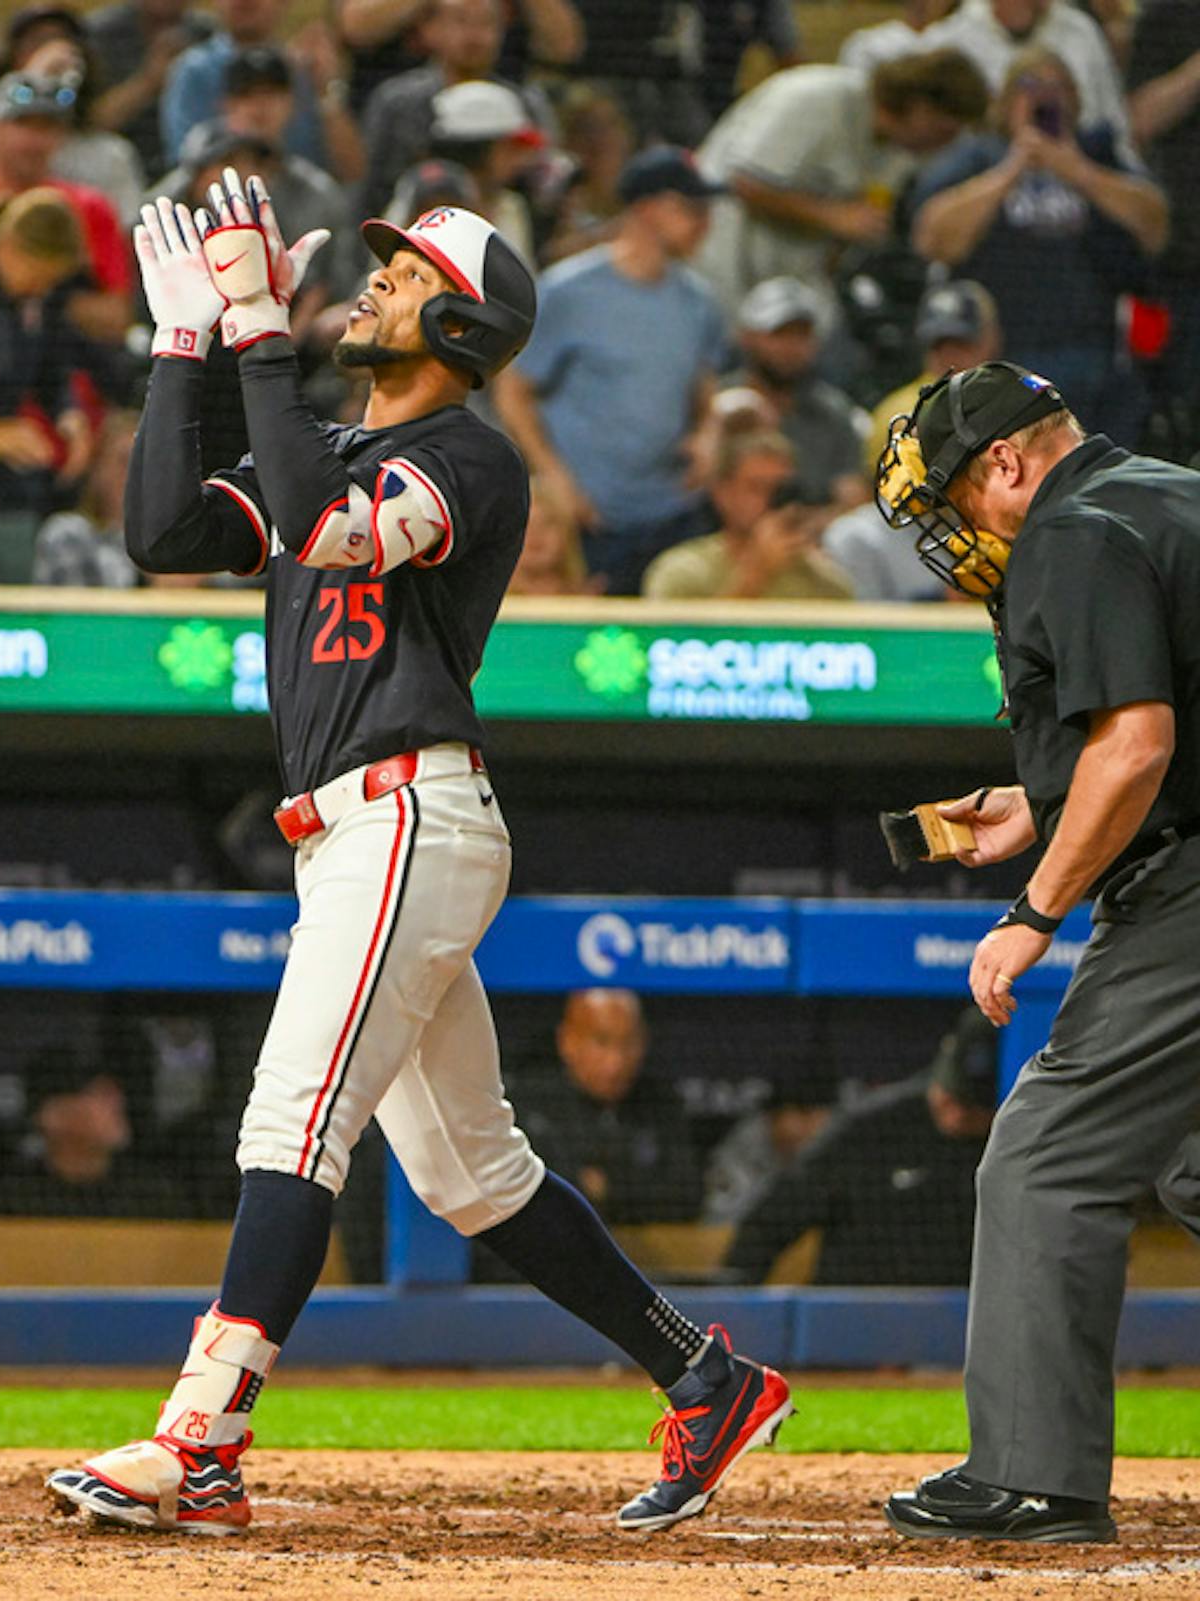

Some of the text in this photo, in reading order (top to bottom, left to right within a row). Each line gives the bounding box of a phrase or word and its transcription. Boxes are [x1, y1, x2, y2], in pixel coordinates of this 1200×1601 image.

[311, 583, 386, 664] 25
[647, 638, 877, 691] securian
[638, 923, 790, 968] TickPick
[184, 1410, 211, 1440] 25
